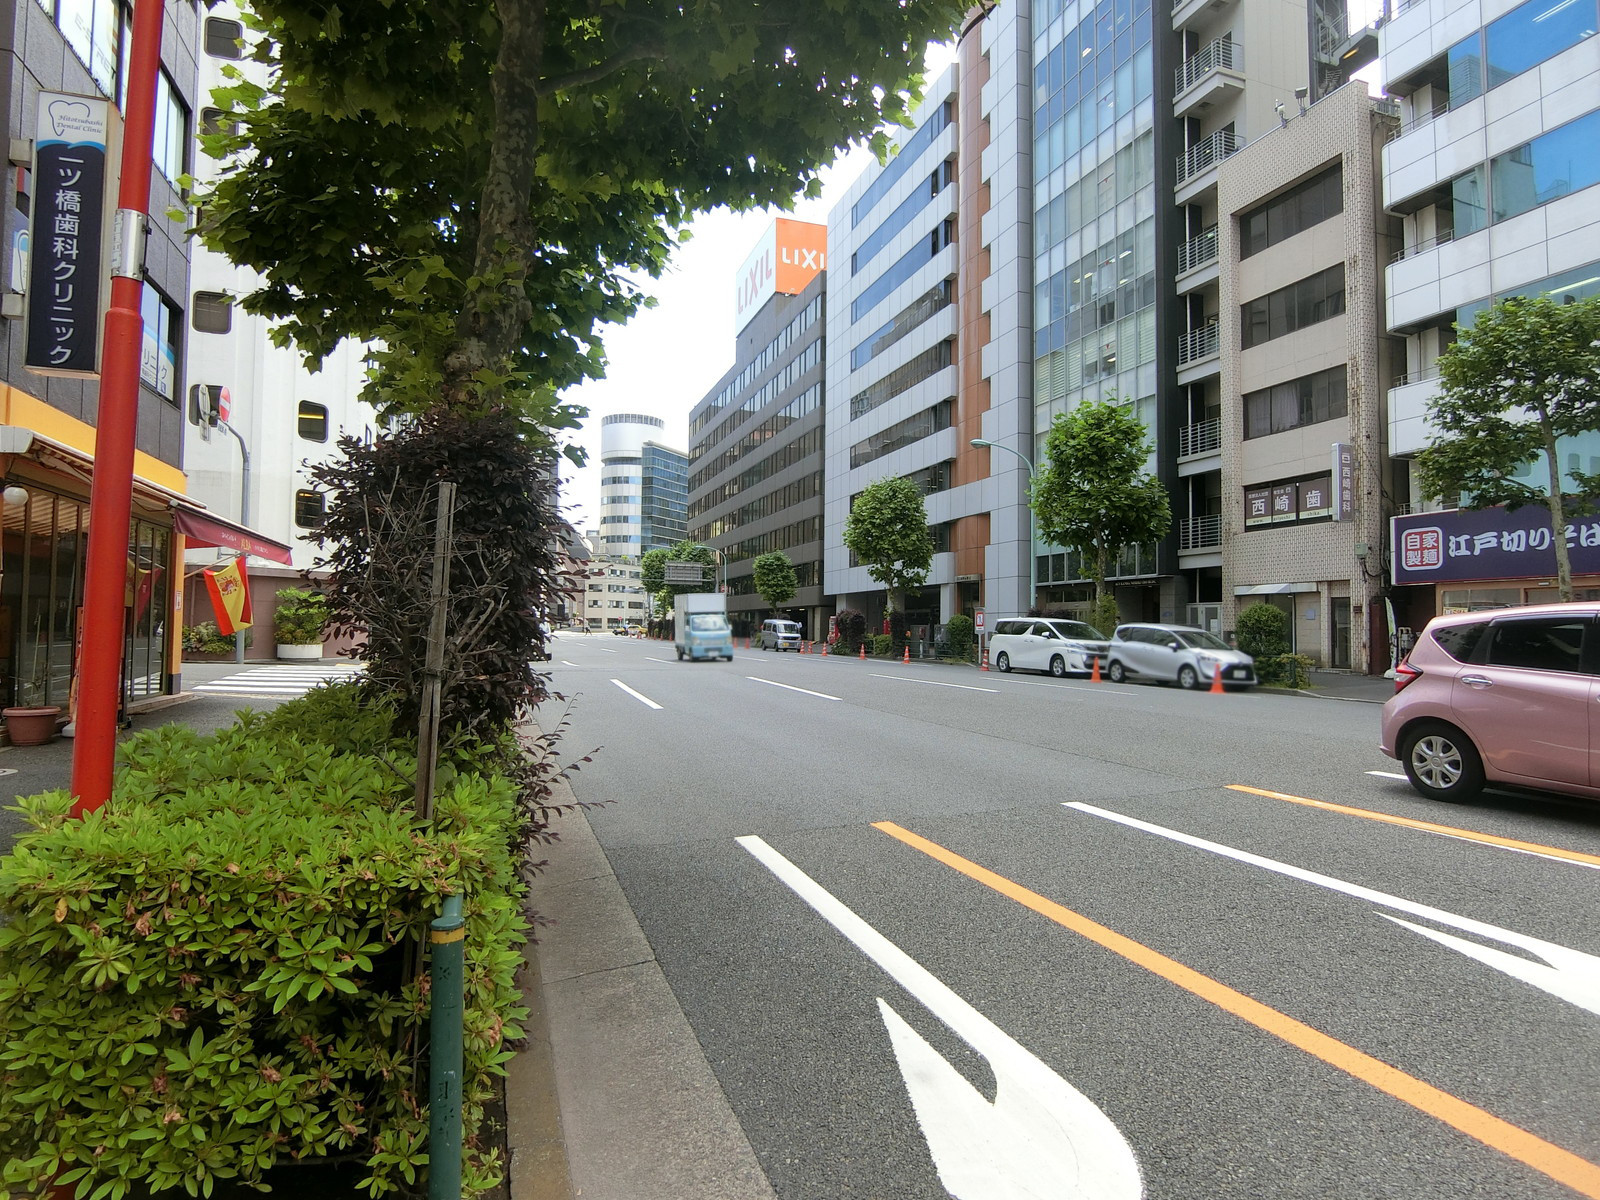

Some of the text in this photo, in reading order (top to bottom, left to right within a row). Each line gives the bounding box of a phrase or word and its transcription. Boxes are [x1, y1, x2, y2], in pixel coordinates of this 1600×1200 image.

[57, 122, 81, 131] Dental
[50, 156, 84, 365] 一ツ橋歯科クリニック
[738, 248, 772, 315] LIXIL
[1342, 466, 1351, 513] 西崎歯科
